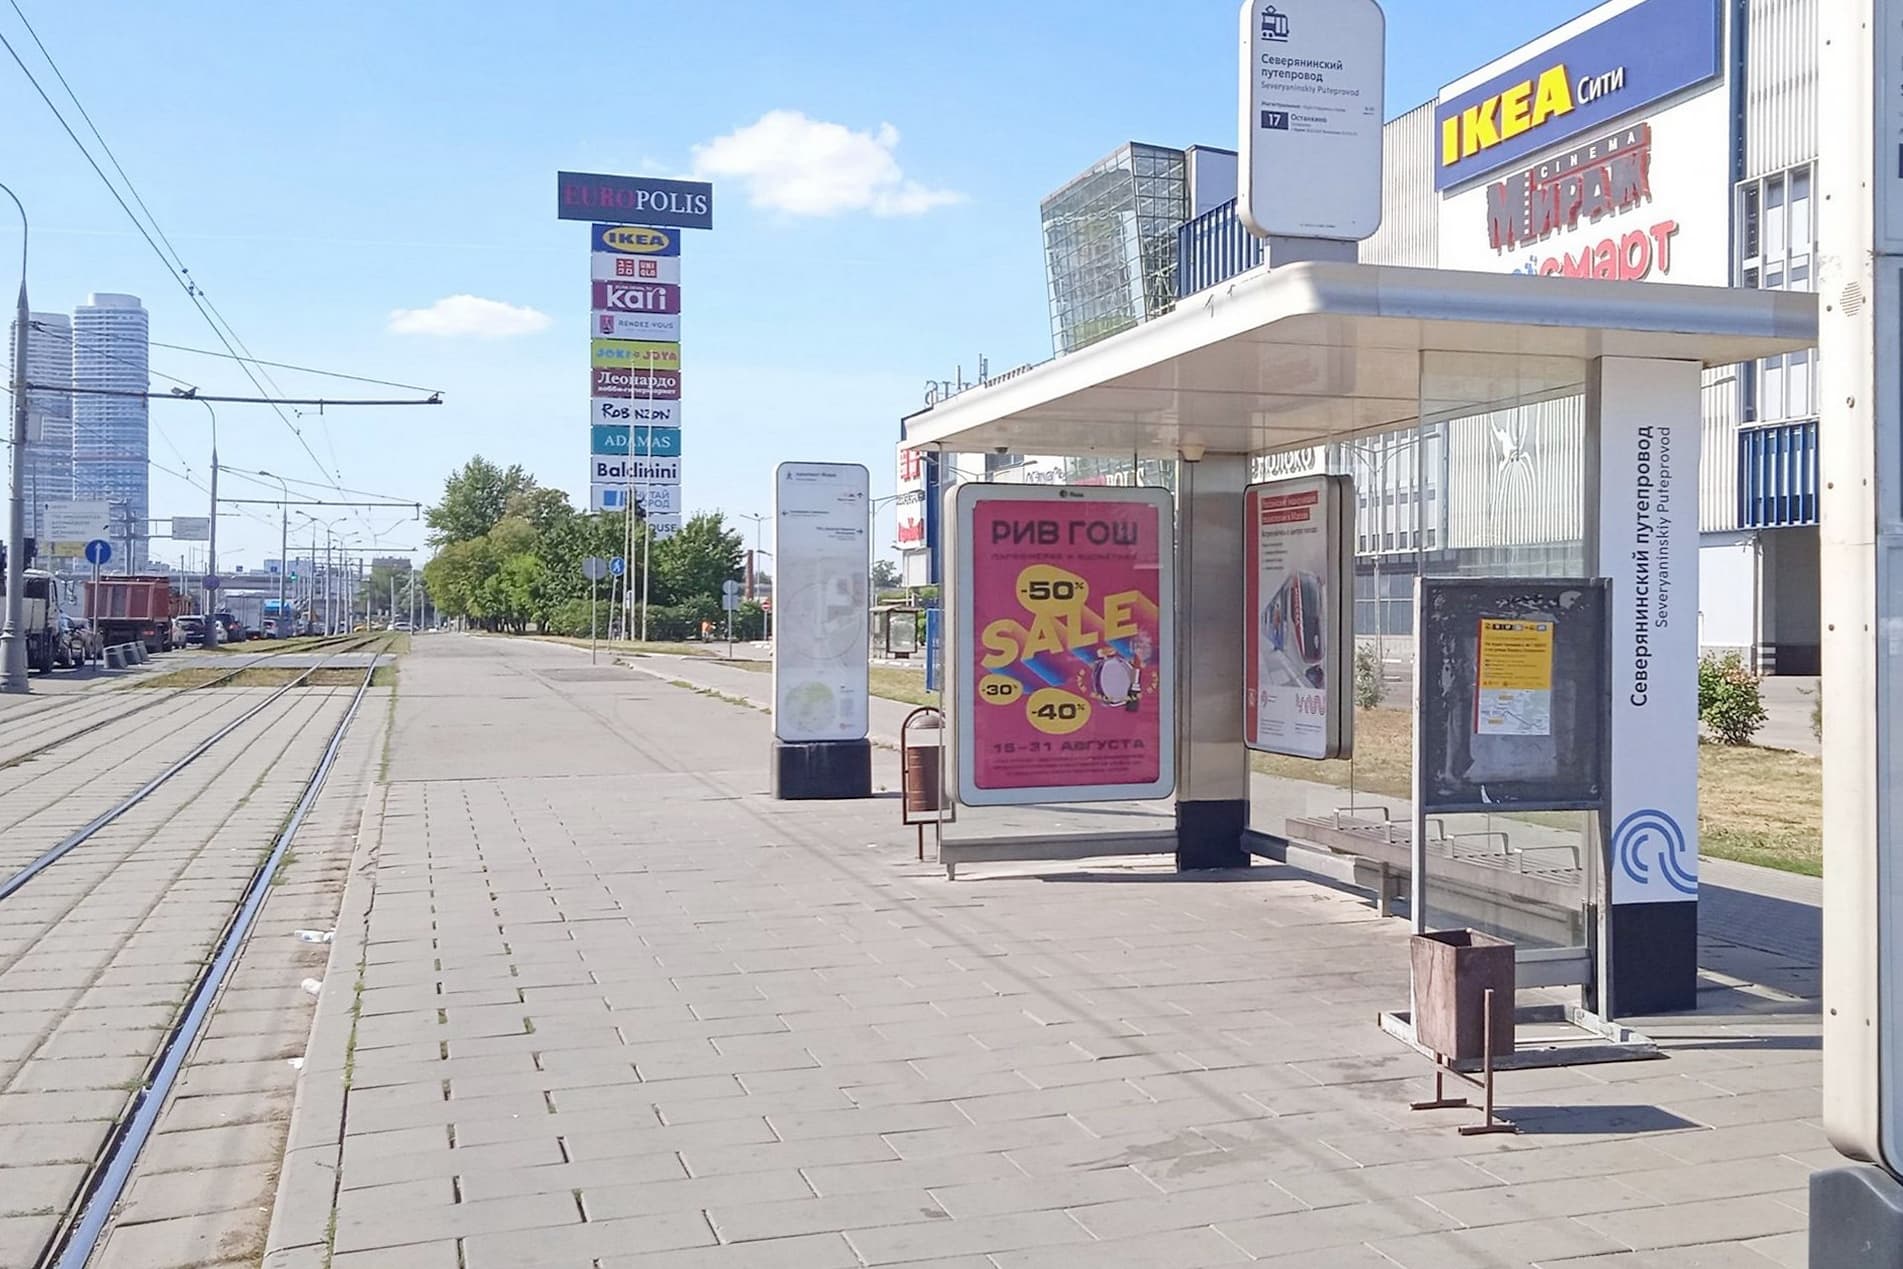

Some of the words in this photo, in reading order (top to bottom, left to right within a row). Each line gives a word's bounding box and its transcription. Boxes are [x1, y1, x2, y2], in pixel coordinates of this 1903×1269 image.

[1261, 53, 1343, 70] Северянинский
[1261, 68, 1324, 82] путепровод
[1268, 113, 1281, 127] 17
[1442, 63, 1575, 167] IKEA
[1577, 67, 1626, 105] Сити
[1540, 131, 1636, 178] CINEMA
[564, 183, 708, 215] EUROPOLIS
[608, 231, 665, 246] IKEA
[606, 285, 667, 310] kari
[598, 371, 676, 387] Леонардо
[597, 462, 677, 478] Baldinini
[1656, 427, 1672, 512] Puteprovod
[1636, 425, 1653, 545] путепровод
[991, 520, 1060, 545] РИВ
[1068, 520, 1138, 545] ГОШ
[1656, 517, 1672, 628] Severyaninskiy
[981, 591, 1138, 669] SALE
[1631, 550, 1652, 707] Северянинский
[1061, 738, 1145, 751] АВГУСТА
